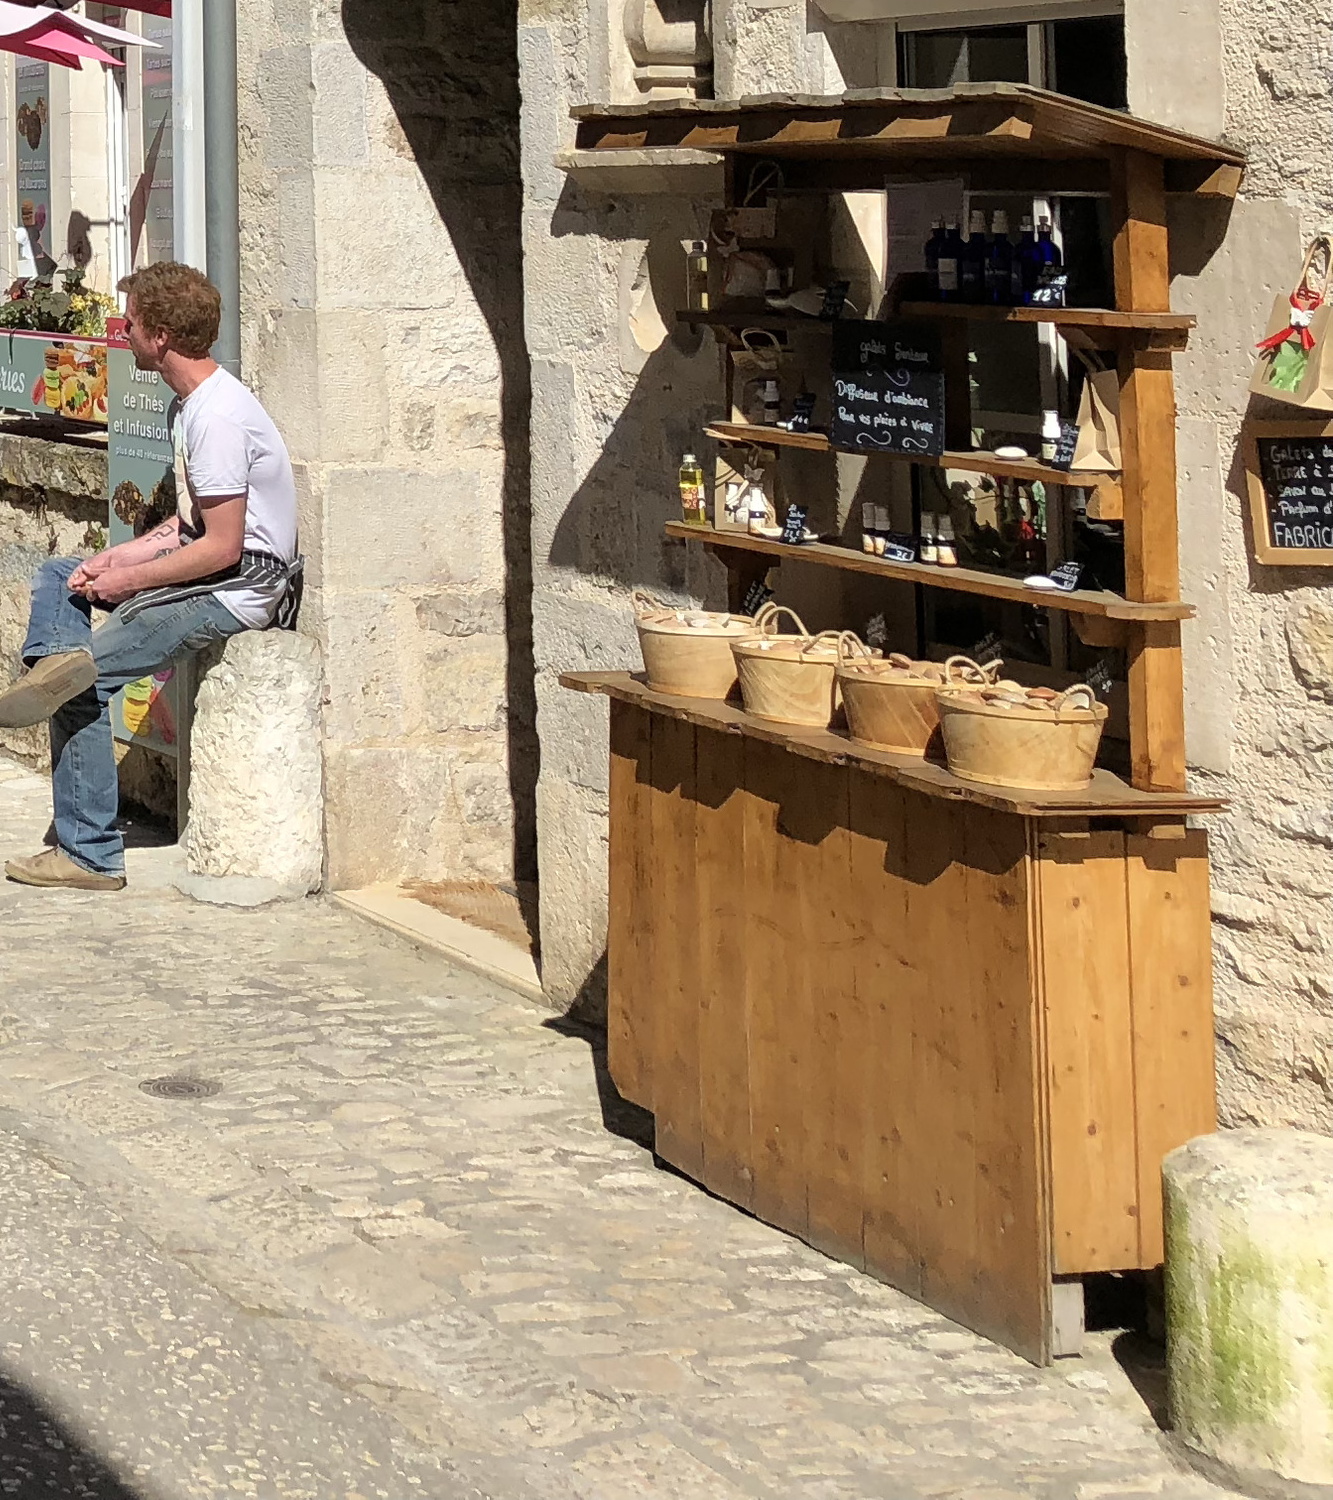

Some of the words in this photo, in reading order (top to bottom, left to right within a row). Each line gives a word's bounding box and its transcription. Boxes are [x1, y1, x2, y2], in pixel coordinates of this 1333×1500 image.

[129, 364, 159, 385] Vente
[123, 391, 137, 409] de
[138, 392, 165, 413] Thés
[113, 418, 124, 434] et
